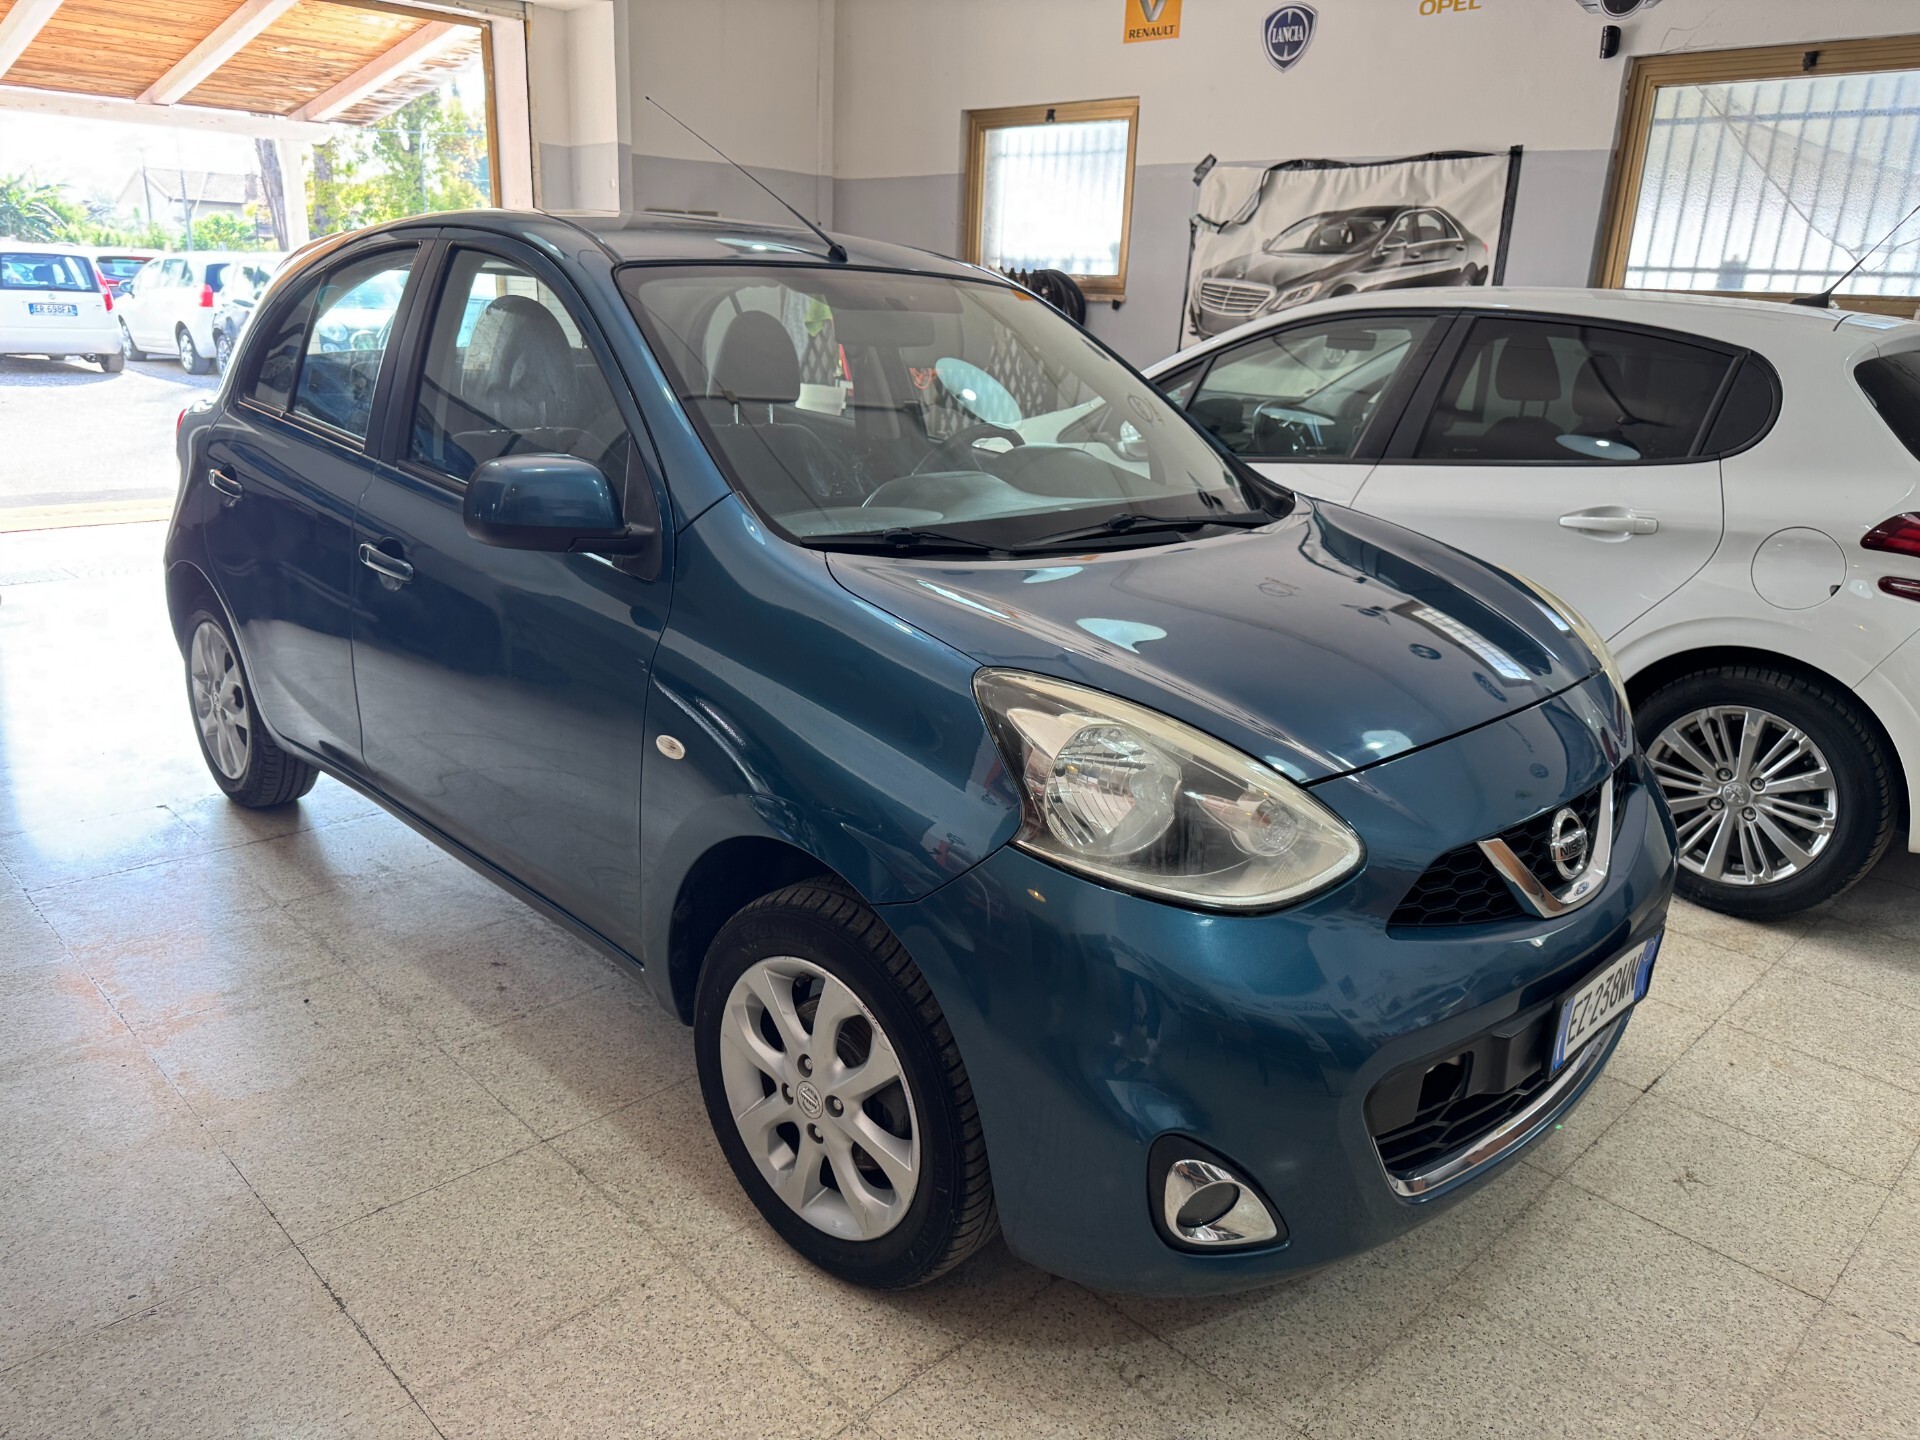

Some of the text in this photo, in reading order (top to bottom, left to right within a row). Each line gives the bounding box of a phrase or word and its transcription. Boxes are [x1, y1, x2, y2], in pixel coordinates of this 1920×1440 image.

[1419, 0, 1482, 16] OPEL
[1128, 25, 1176, 39] RENAULT
[1271, 25, 1304, 44] LANCIA
